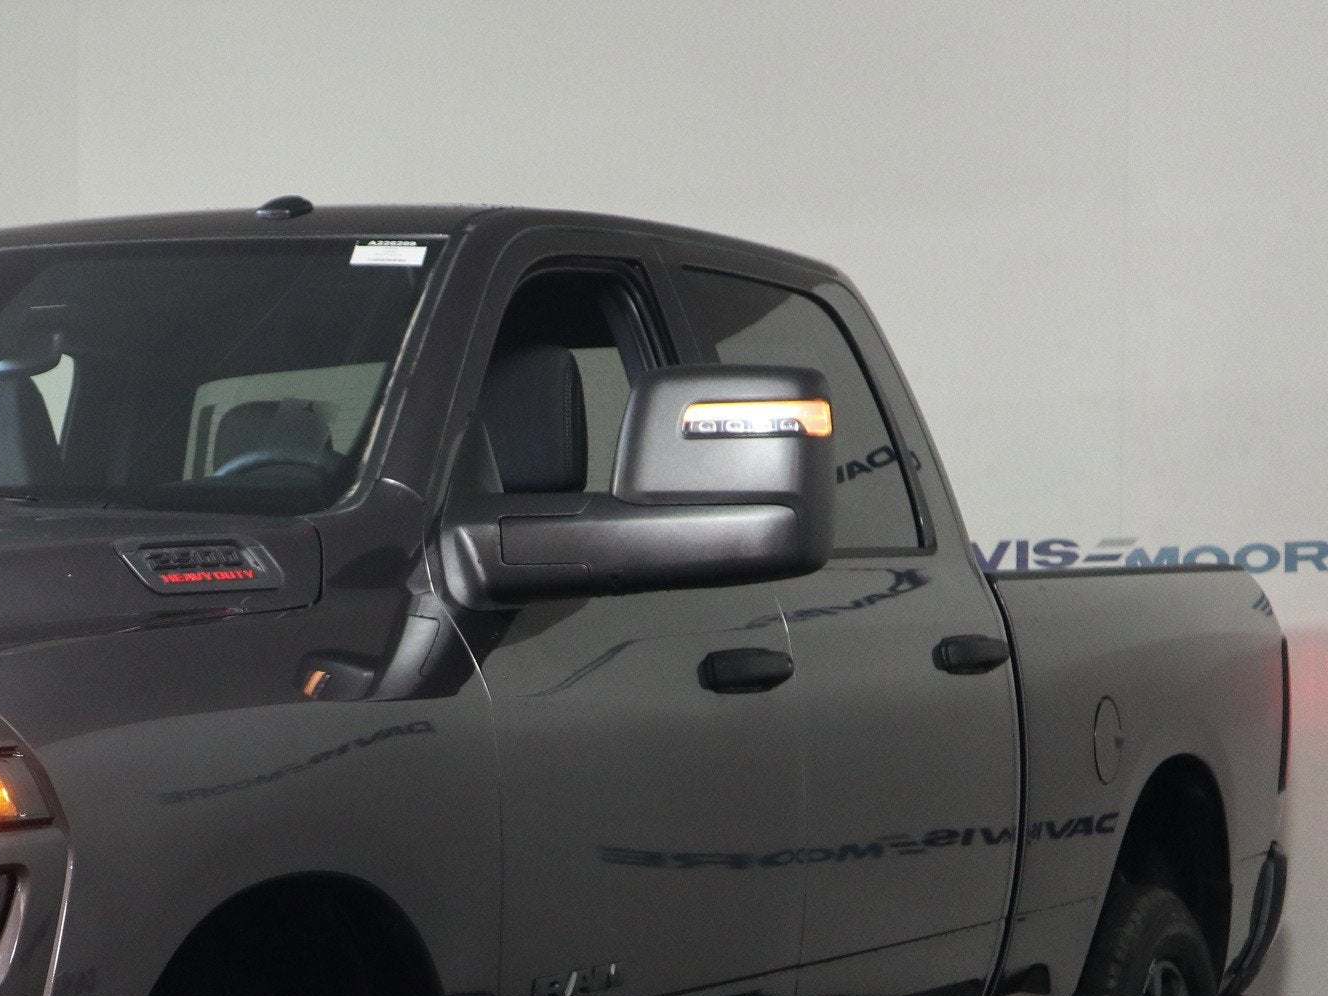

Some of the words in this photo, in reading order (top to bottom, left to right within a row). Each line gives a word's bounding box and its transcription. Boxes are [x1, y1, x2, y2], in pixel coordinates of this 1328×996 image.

[969, 538, 1079, 573] VIS
[1125, 540, 1328, 574] MOOR
[160, 571, 213, 584] HEAVY
[213, 569, 255, 581] DUTY
